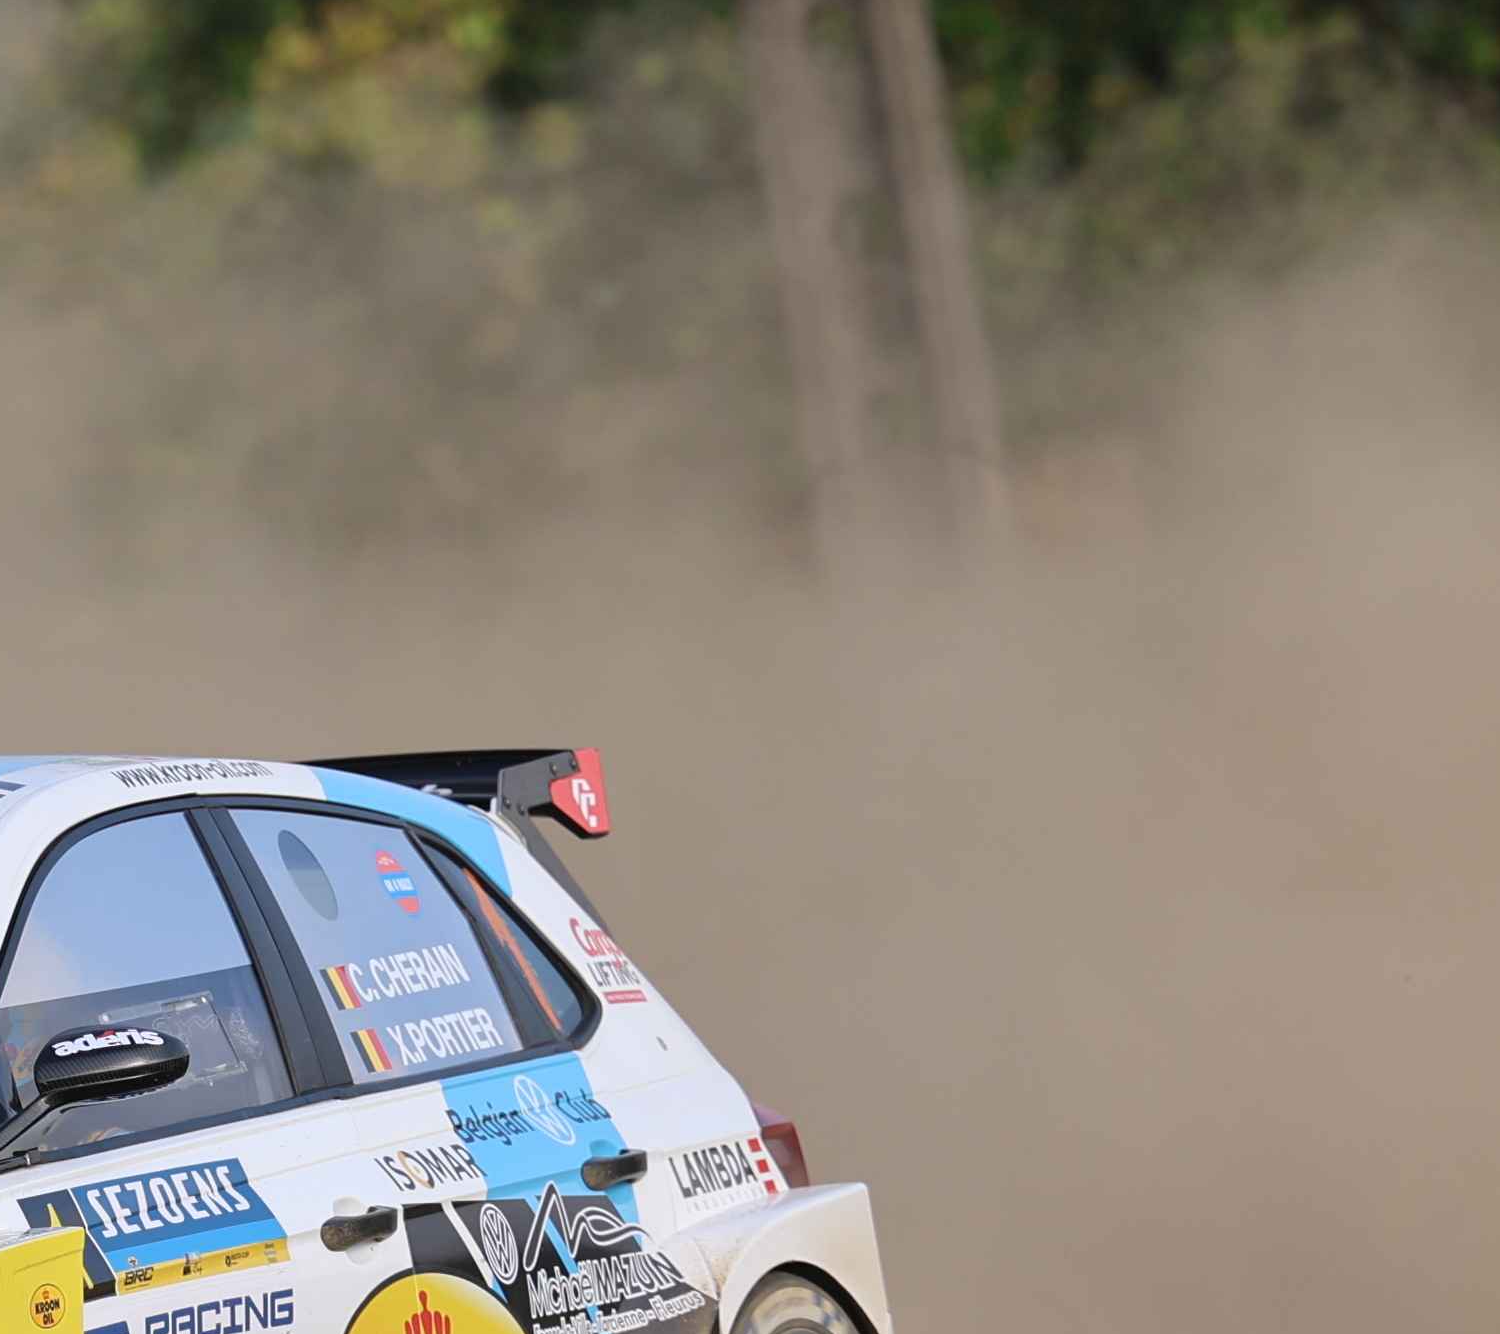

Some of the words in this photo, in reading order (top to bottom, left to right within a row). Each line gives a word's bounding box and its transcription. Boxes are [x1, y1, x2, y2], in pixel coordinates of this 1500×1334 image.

[347, 943, 471, 1003] C.CHERAIN
[386, 1007, 503, 1066] X.PORTIER
[446, 1101, 534, 1146] Belgian
[553, 1089, 611, 1124] Club
[374, 1143, 487, 1191] ISOMAR
[668, 1141, 758, 1199] LAMBDA
[86, 1166, 250, 1238] SEZOENS
[124, 1267, 154, 1285] BRC
[35, 1298, 60, 1316] KROON
[43, 1314, 55, 1325] OIL
[649, 1289, 705, 1321] Fleurus
